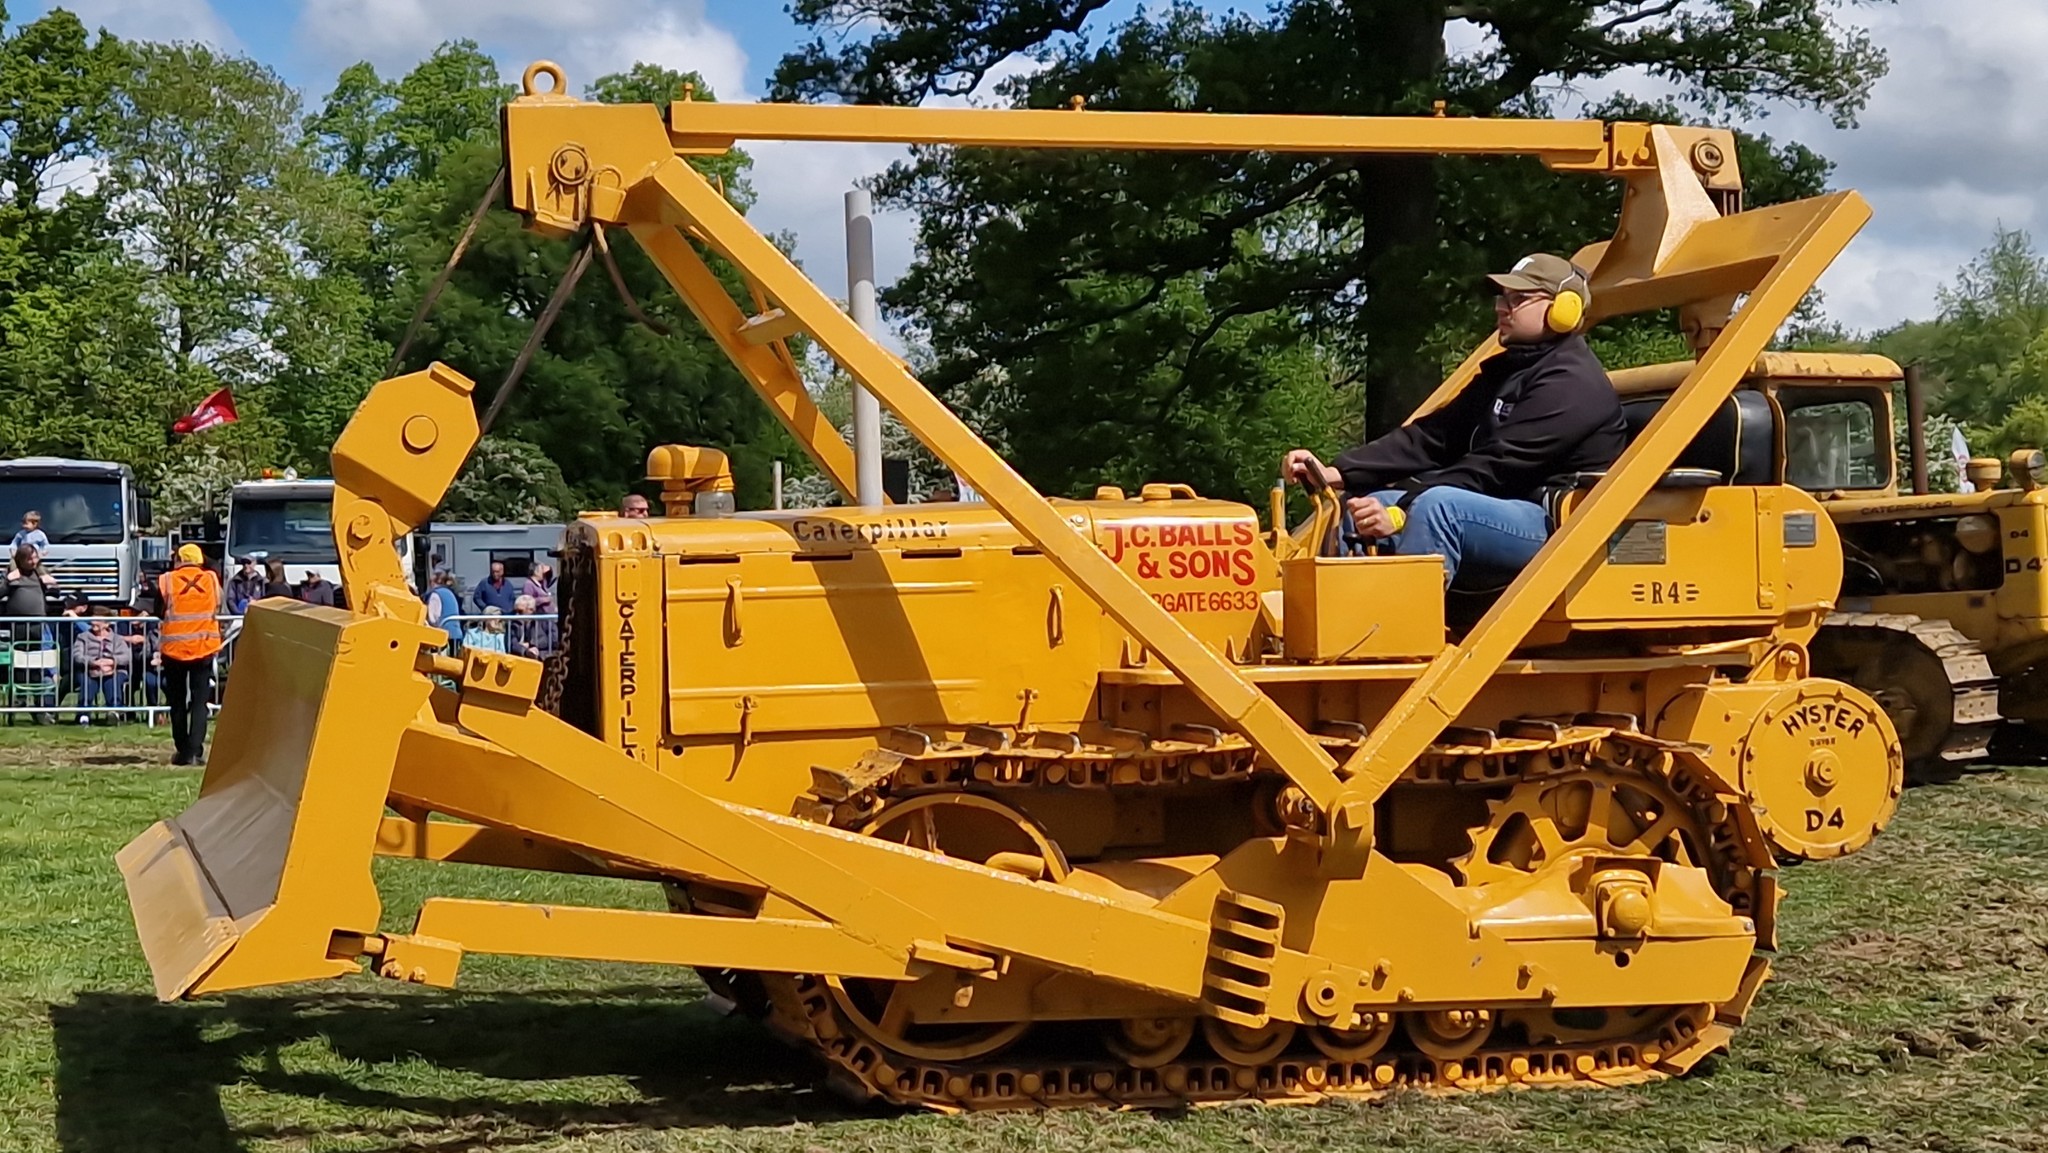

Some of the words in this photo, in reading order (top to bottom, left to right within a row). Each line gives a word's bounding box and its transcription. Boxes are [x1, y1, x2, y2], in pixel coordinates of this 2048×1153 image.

[793, 518, 949, 544] Caterpillar
[1137, 552, 1163, 579] &
[1168, 549, 1256, 586] SONS
[1650, 581, 1680, 604] R4
[1781, 704, 1865, 740] HYSTER
[1805, 806, 1845, 833] D4
